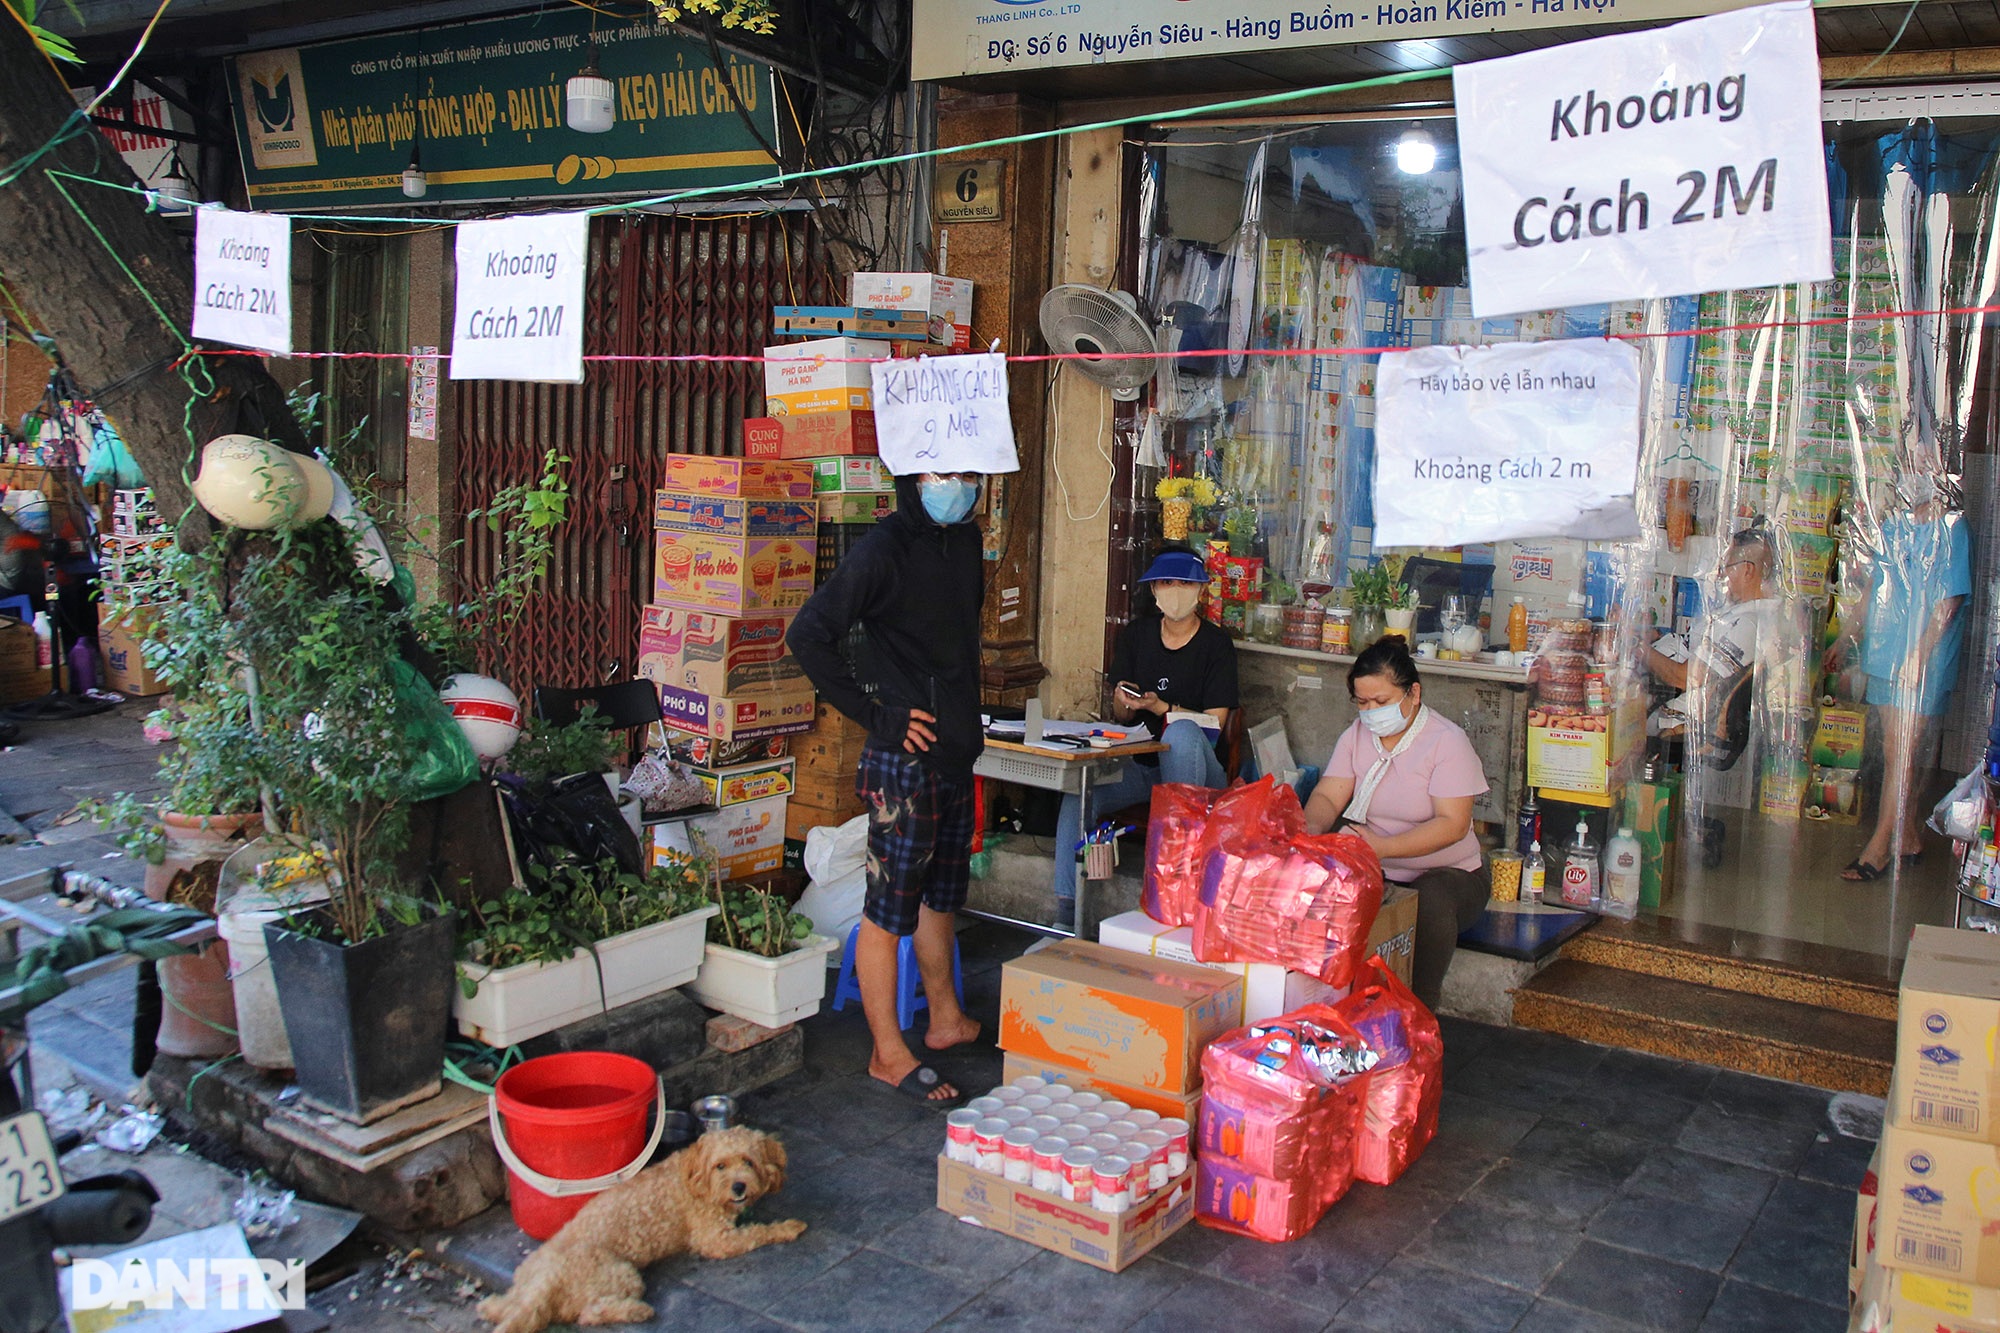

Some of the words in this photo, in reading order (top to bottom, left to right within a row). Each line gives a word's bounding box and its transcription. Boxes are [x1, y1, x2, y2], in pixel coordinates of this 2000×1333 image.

[976, 12, 1010, 25] THANG
[1013, 9, 1036, 21] LINH
[1060, 4, 1081, 15] LTD
[1026, 32, 1054, 56] Số
[1056, 34, 1068, 54] 6
[1079, 24, 1152, 57] Nguyễn
[1160, 22, 1204, 45] Siêu
[1226, 17, 1282, 41] Hàng
[1290, 7, 1355, 33] Buồm
[1377, 2, 1438, 26] Hoàn
[350, 58, 377, 76] CÔNG
[379, 58, 389, 72] TY
[513, 34, 551, 54] LƯƠNG
[552, 33, 580, 53] THỰC
[320, 106, 351, 148] Nhà
[351, 104, 386, 154] phân
[386, 92, 417, 152] phối
[417, 76, 463, 140] TỔNG
[463, 85, 496, 147] HỢP
[507, 86, 539, 144] ĐẠI
[539, 72, 561, 129] LÝ
[618, 73, 659, 134] KẸO
[661, 52, 697, 118] HẢI
[956, 168, 978, 203] 6
[1513, 178, 1651, 248] Cách
[1671, 157, 1778, 225] 2M
[975, 205, 994, 215] SIÊU
[485, 244, 558, 280] Khoảng
[206, 281, 245, 311] Cách
[249, 287, 276, 315] 2M
[469, 306, 518, 340] Cách
[524, 304, 564, 337] 2M
[1452, 371, 1484, 392] bảo
[1489, 372, 1512, 394] vệ
[1516, 367, 1544, 391] lẫn
[1550, 371, 1597, 390] nhau
[915, 418, 940, 459] 2
[1413, 456, 1493, 485] Khoảng
[1498, 456, 1543, 480] Cách
[1549, 456, 1563, 479] 2
[1570, 460, 1592, 479] m
[1567, 869, 1586, 882] Lily
